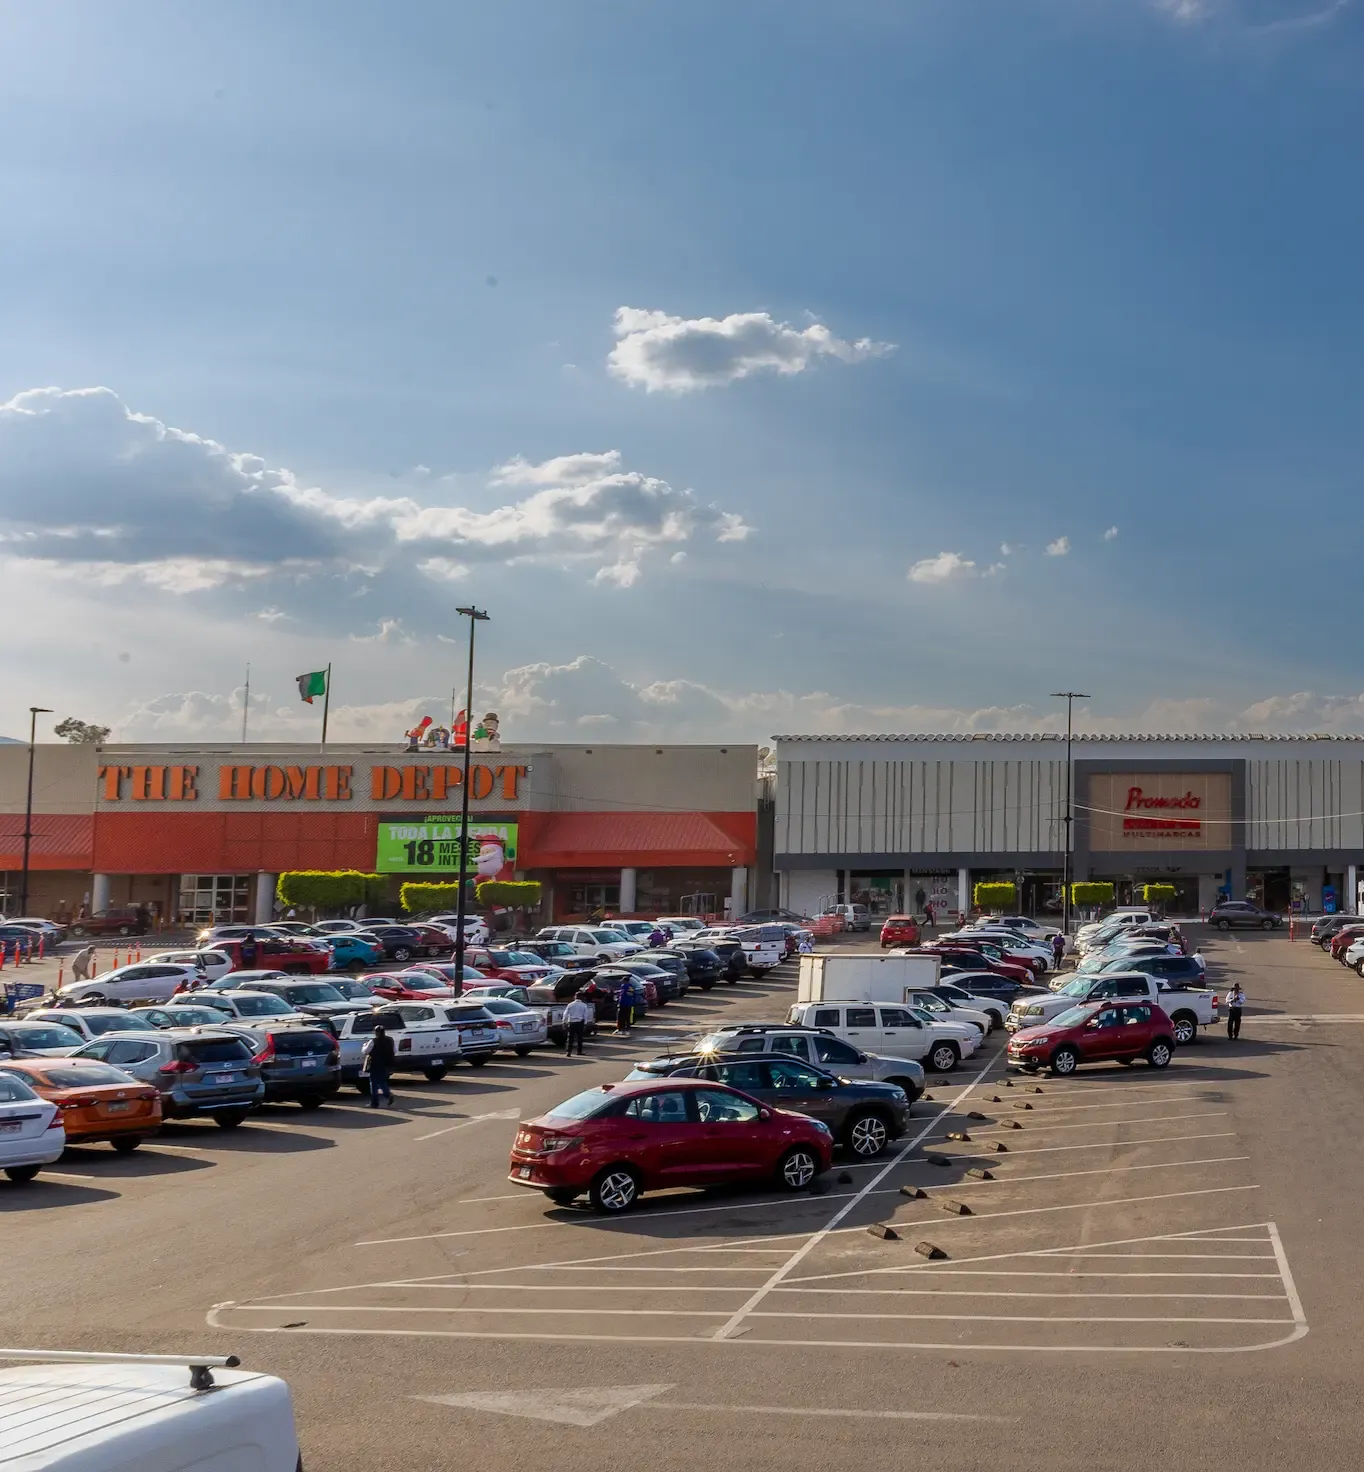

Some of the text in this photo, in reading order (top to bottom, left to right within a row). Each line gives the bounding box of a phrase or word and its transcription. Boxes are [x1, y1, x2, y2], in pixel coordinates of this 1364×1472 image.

[98, 765, 528, 801] THE HOME DEPOT
[1123, 787, 1201, 812] Promoda
[389, 826, 509, 840] TODA LA TENDA
[404, 840, 435, 866] 18
